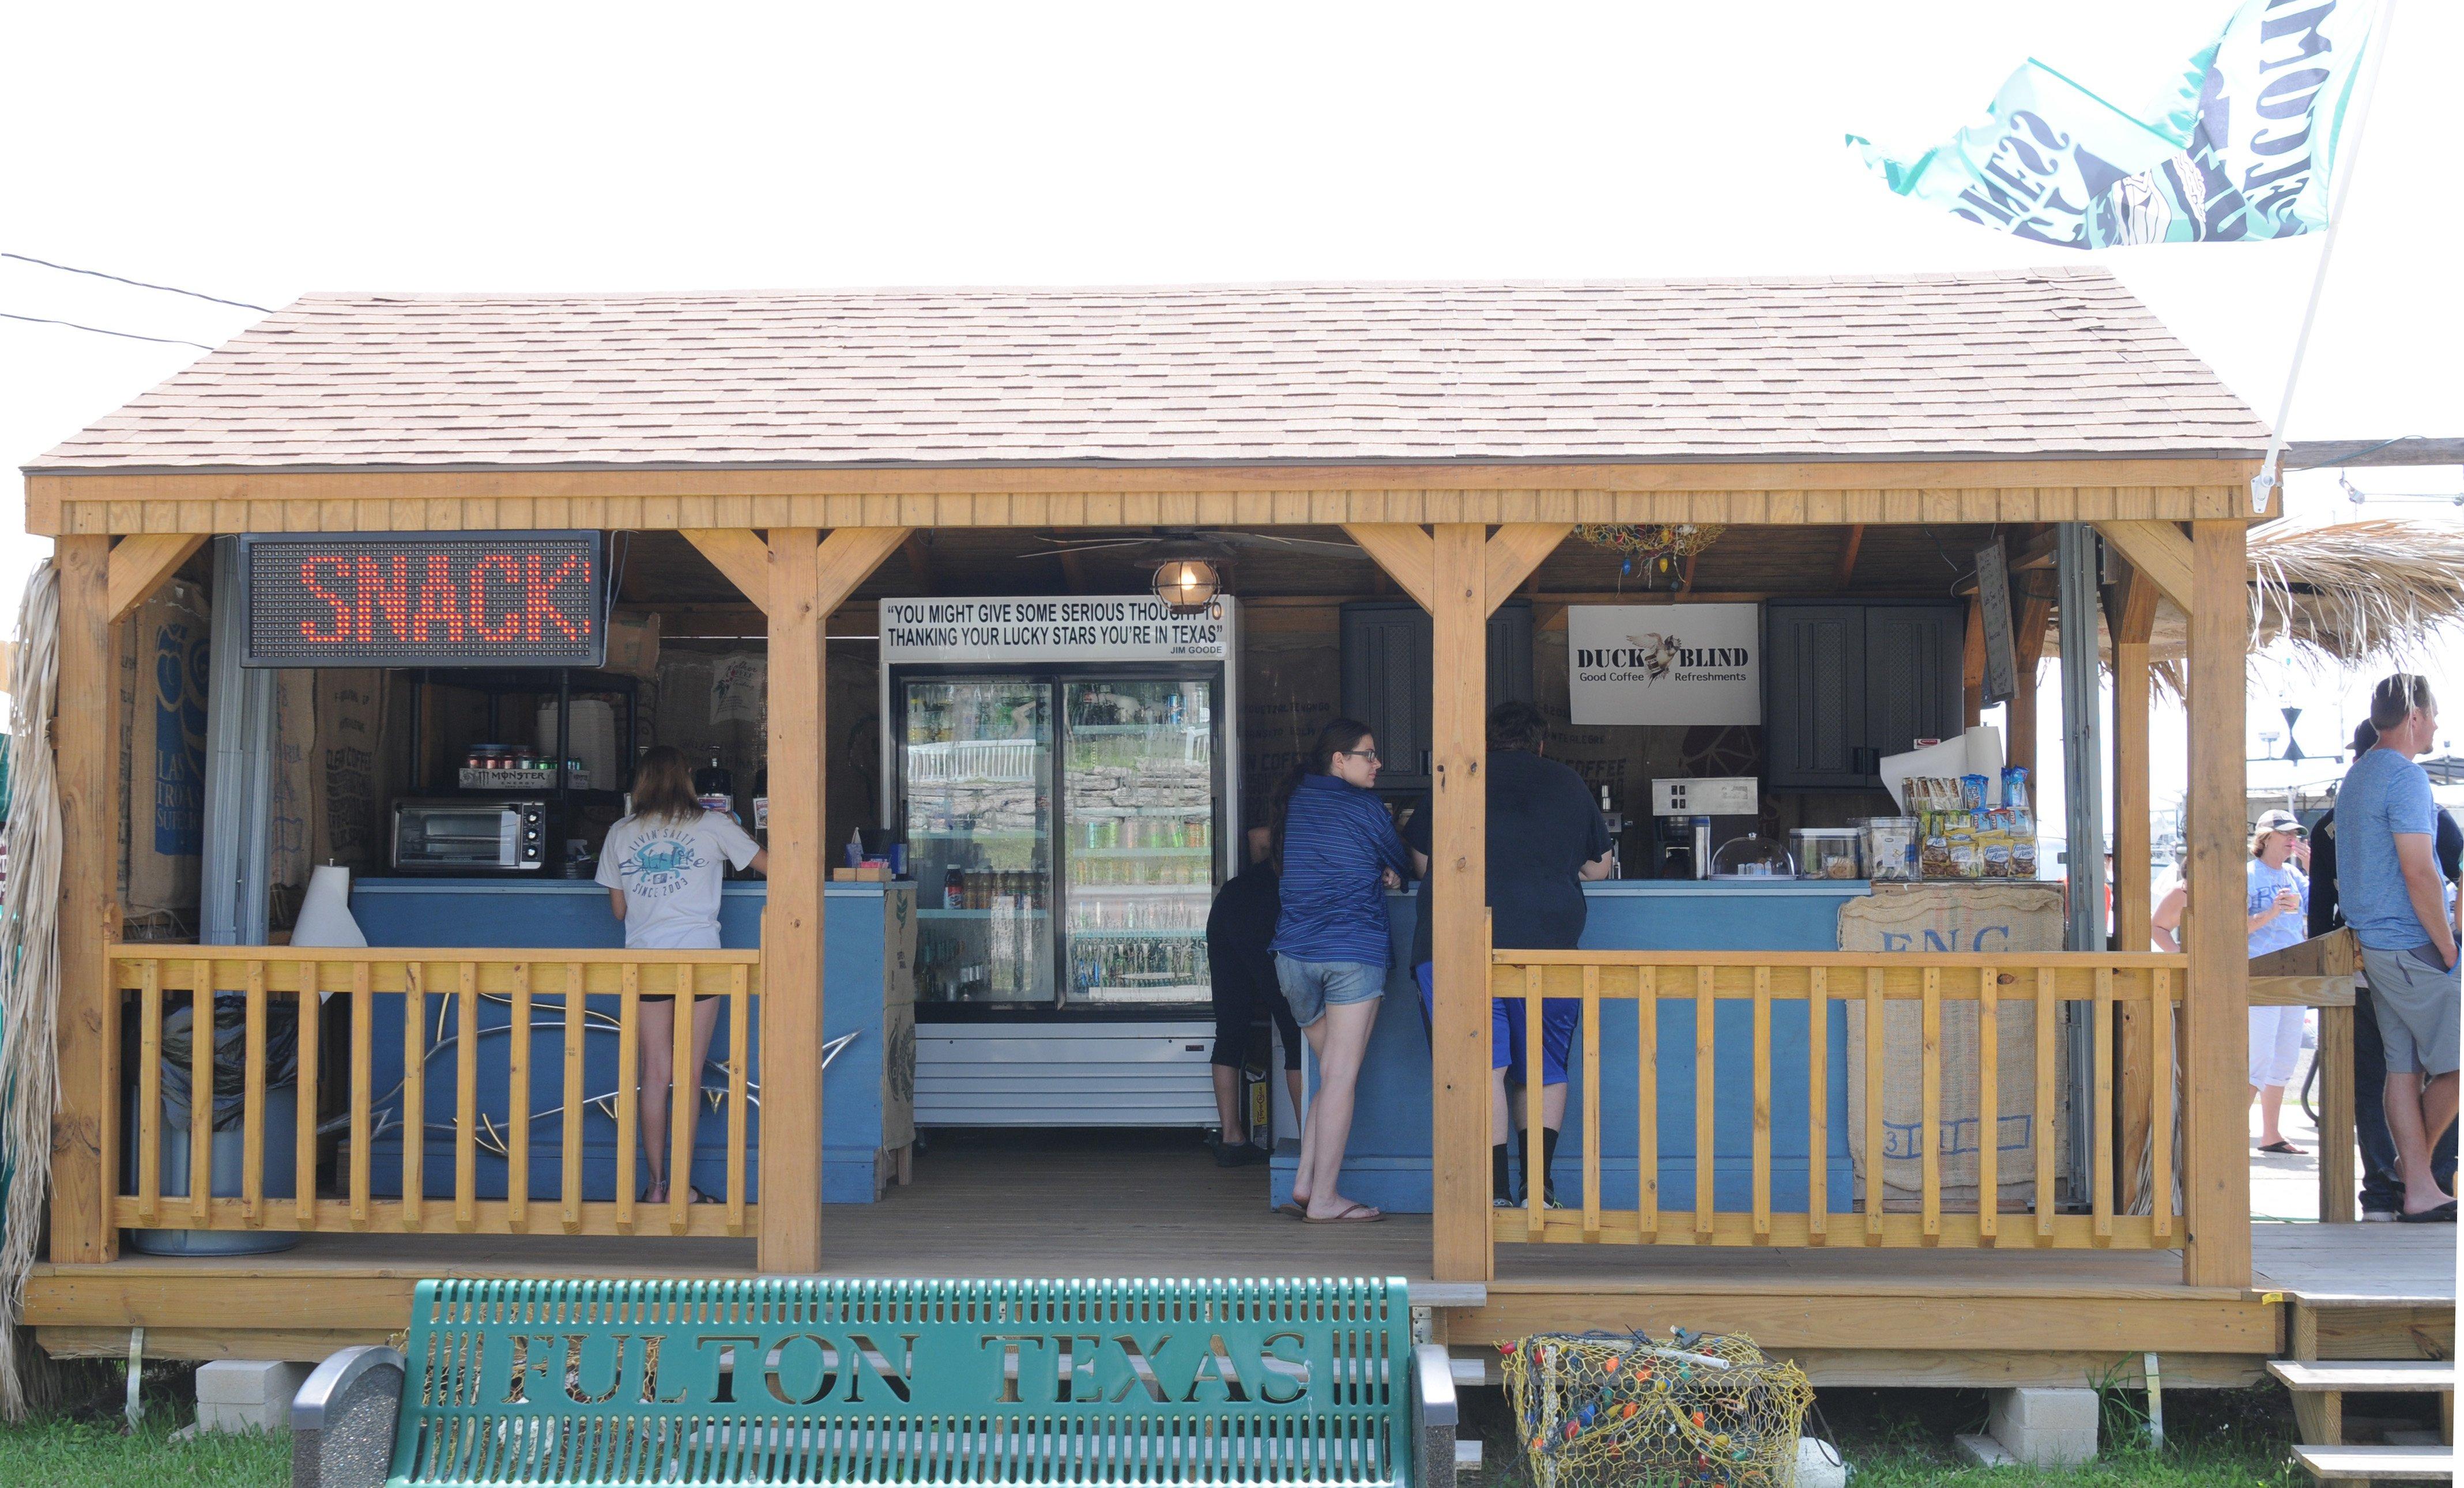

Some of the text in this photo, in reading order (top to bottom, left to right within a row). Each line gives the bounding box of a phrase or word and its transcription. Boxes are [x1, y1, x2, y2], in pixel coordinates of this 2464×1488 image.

[929, 604, 974, 623] MIGHT
[978, 604, 1011, 623] GIVE
[1016, 603, 1057, 623] SOME
[1061, 603, 1124, 622] SERIOUS
[888, 627, 958, 647] THANKING
[961, 627, 1000, 646] YOUR
[1004, 627, 1049, 646] LUCKY
[1053, 626, 1096, 645] STARS
[1155, 626, 1167, 644] IN
[1188, 646, 1222, 654] GOODE
[1577, 647, 1749, 668] DUCK BLIND
[1580, 672, 1746, 682] Good Coffee Refreshments
[491, 770, 545, 781] MONSTER
[663, 828, 696, 846] SALTY
[632, 877, 689, 898] SINCE 2003
[503, 1331, 1309, 1407] FULTON TEXAS
